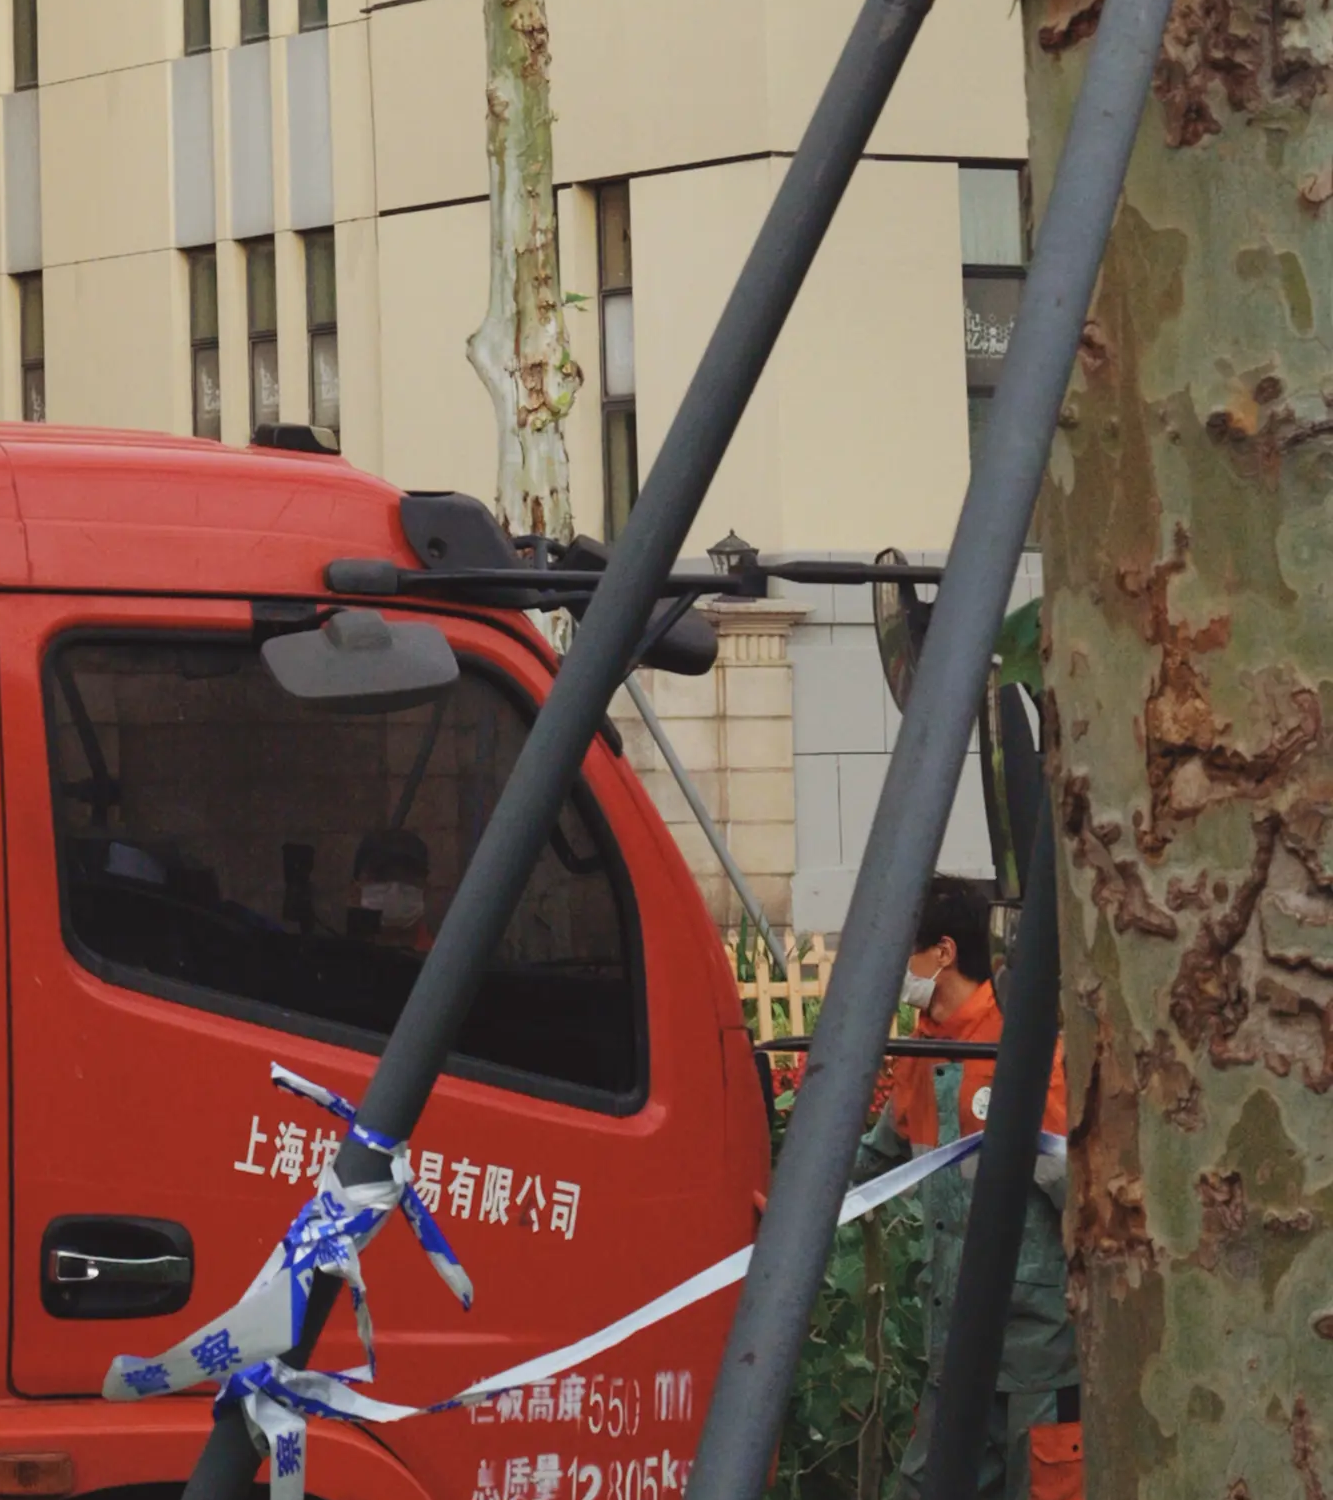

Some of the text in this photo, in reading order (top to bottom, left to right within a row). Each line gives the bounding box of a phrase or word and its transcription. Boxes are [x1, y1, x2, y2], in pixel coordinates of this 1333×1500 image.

[234, 1115, 581, 1241] 上海易有限公司
